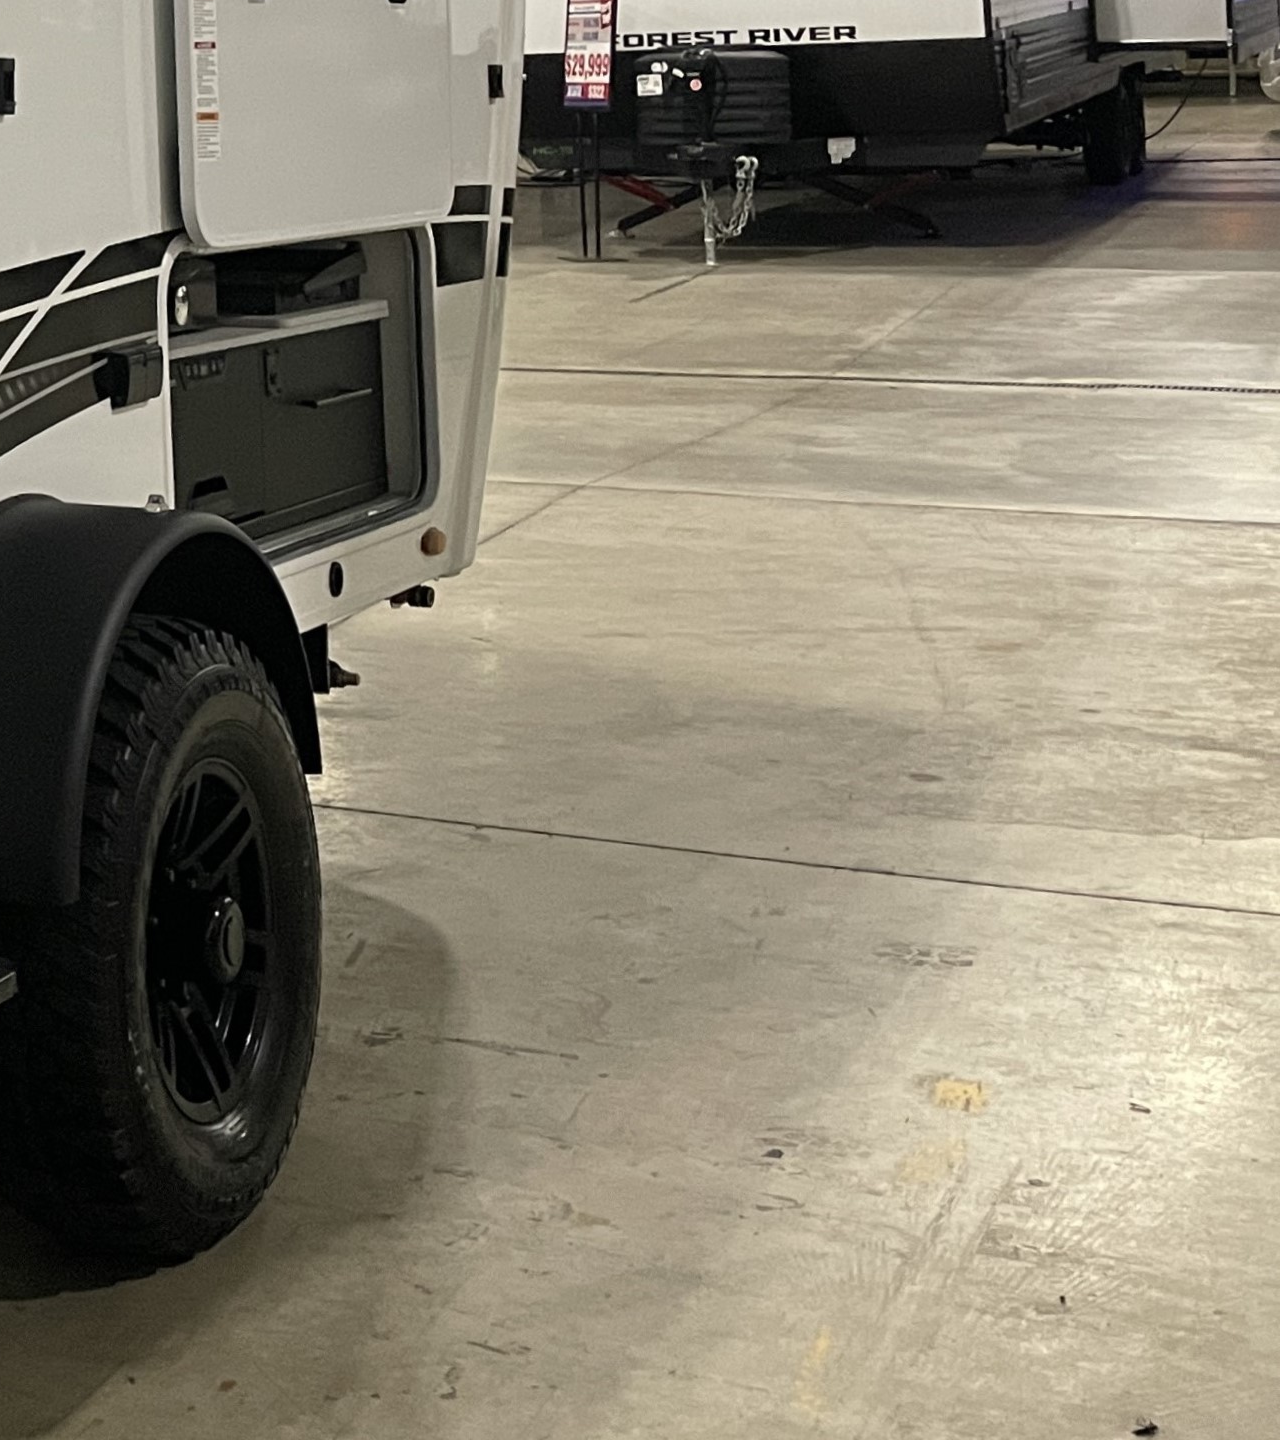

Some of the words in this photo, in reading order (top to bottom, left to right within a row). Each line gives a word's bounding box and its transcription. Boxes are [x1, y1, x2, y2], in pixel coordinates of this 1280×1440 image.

[616, 30, 738, 48] OREST
[748, 26, 857, 43] RIVER
[565, 53, 610, 80] $29,999
